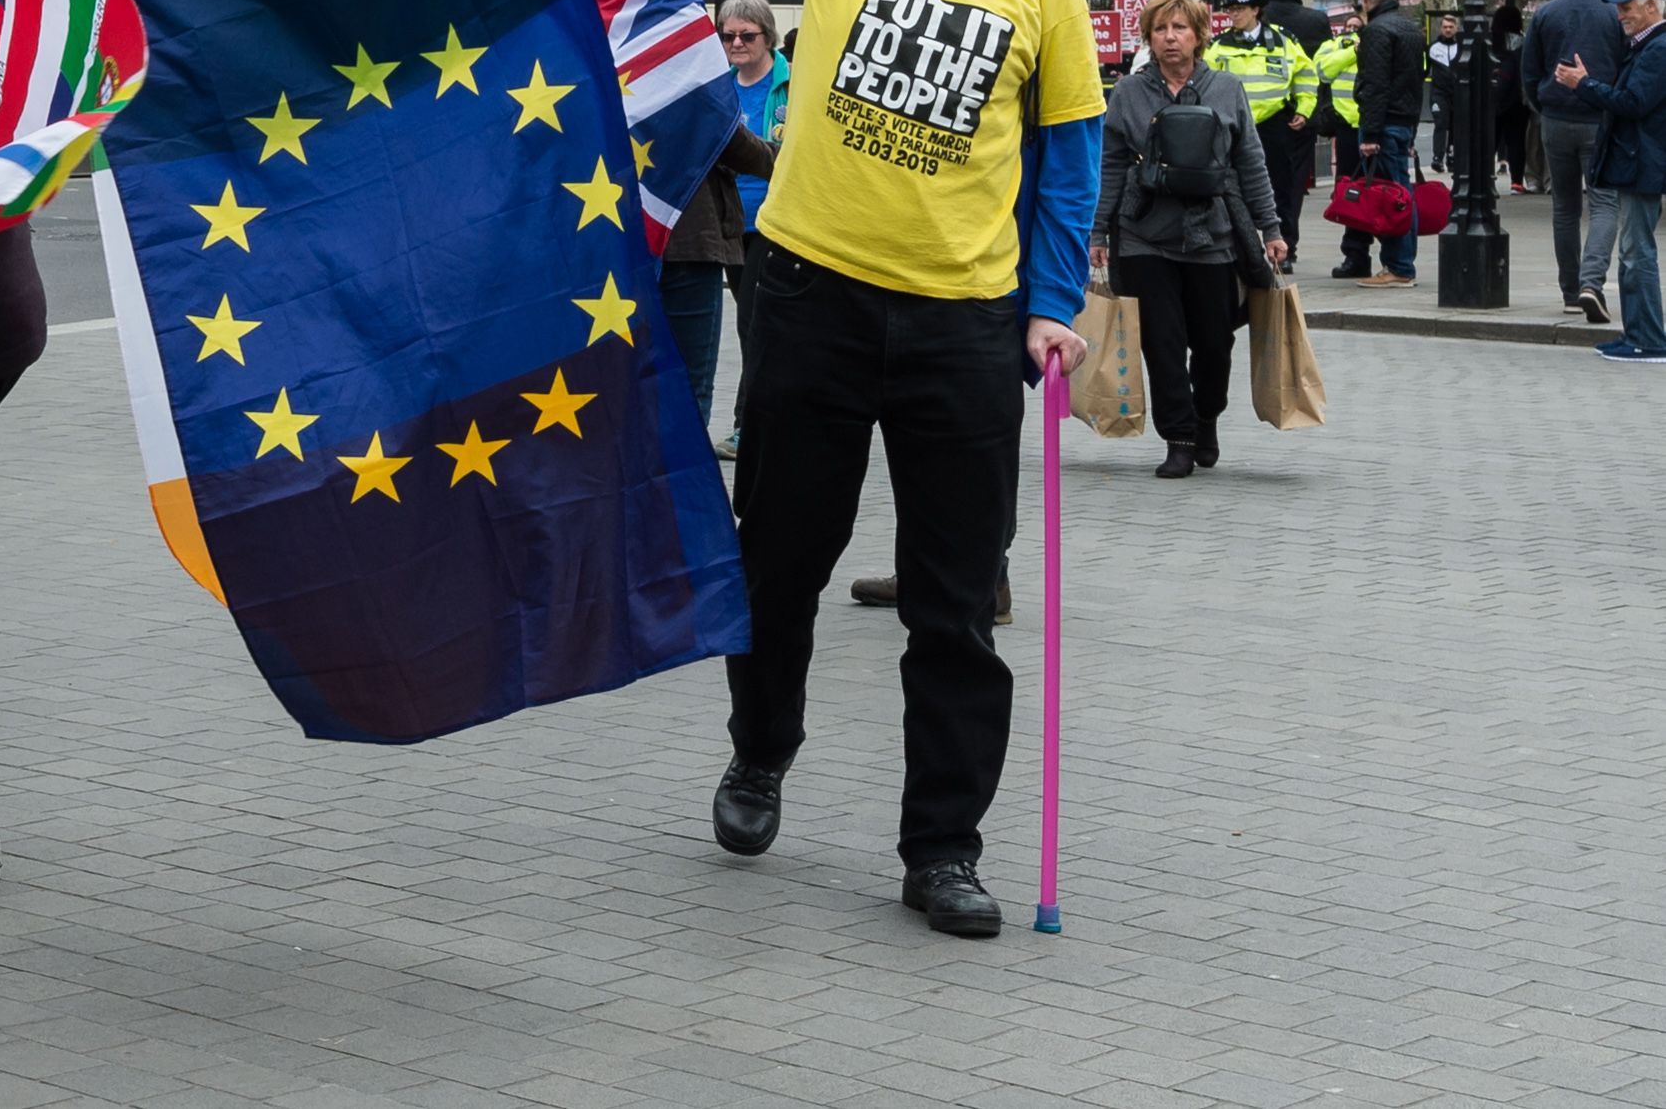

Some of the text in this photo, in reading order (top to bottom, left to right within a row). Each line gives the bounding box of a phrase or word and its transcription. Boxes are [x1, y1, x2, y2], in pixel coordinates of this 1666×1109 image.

[853, 12, 998, 101] TO THE
[960, 7, 1013, 59] IT
[1094, 29, 1110, 40] he
[828, 91, 972, 154] PEOPLE'S VOTE MARCH
[835, 51, 984, 133] PEOPLE
[825, 106, 970, 167] PARK LANE TO PARLIAMENT
[842, 129, 939, 177] 23.03.2019
